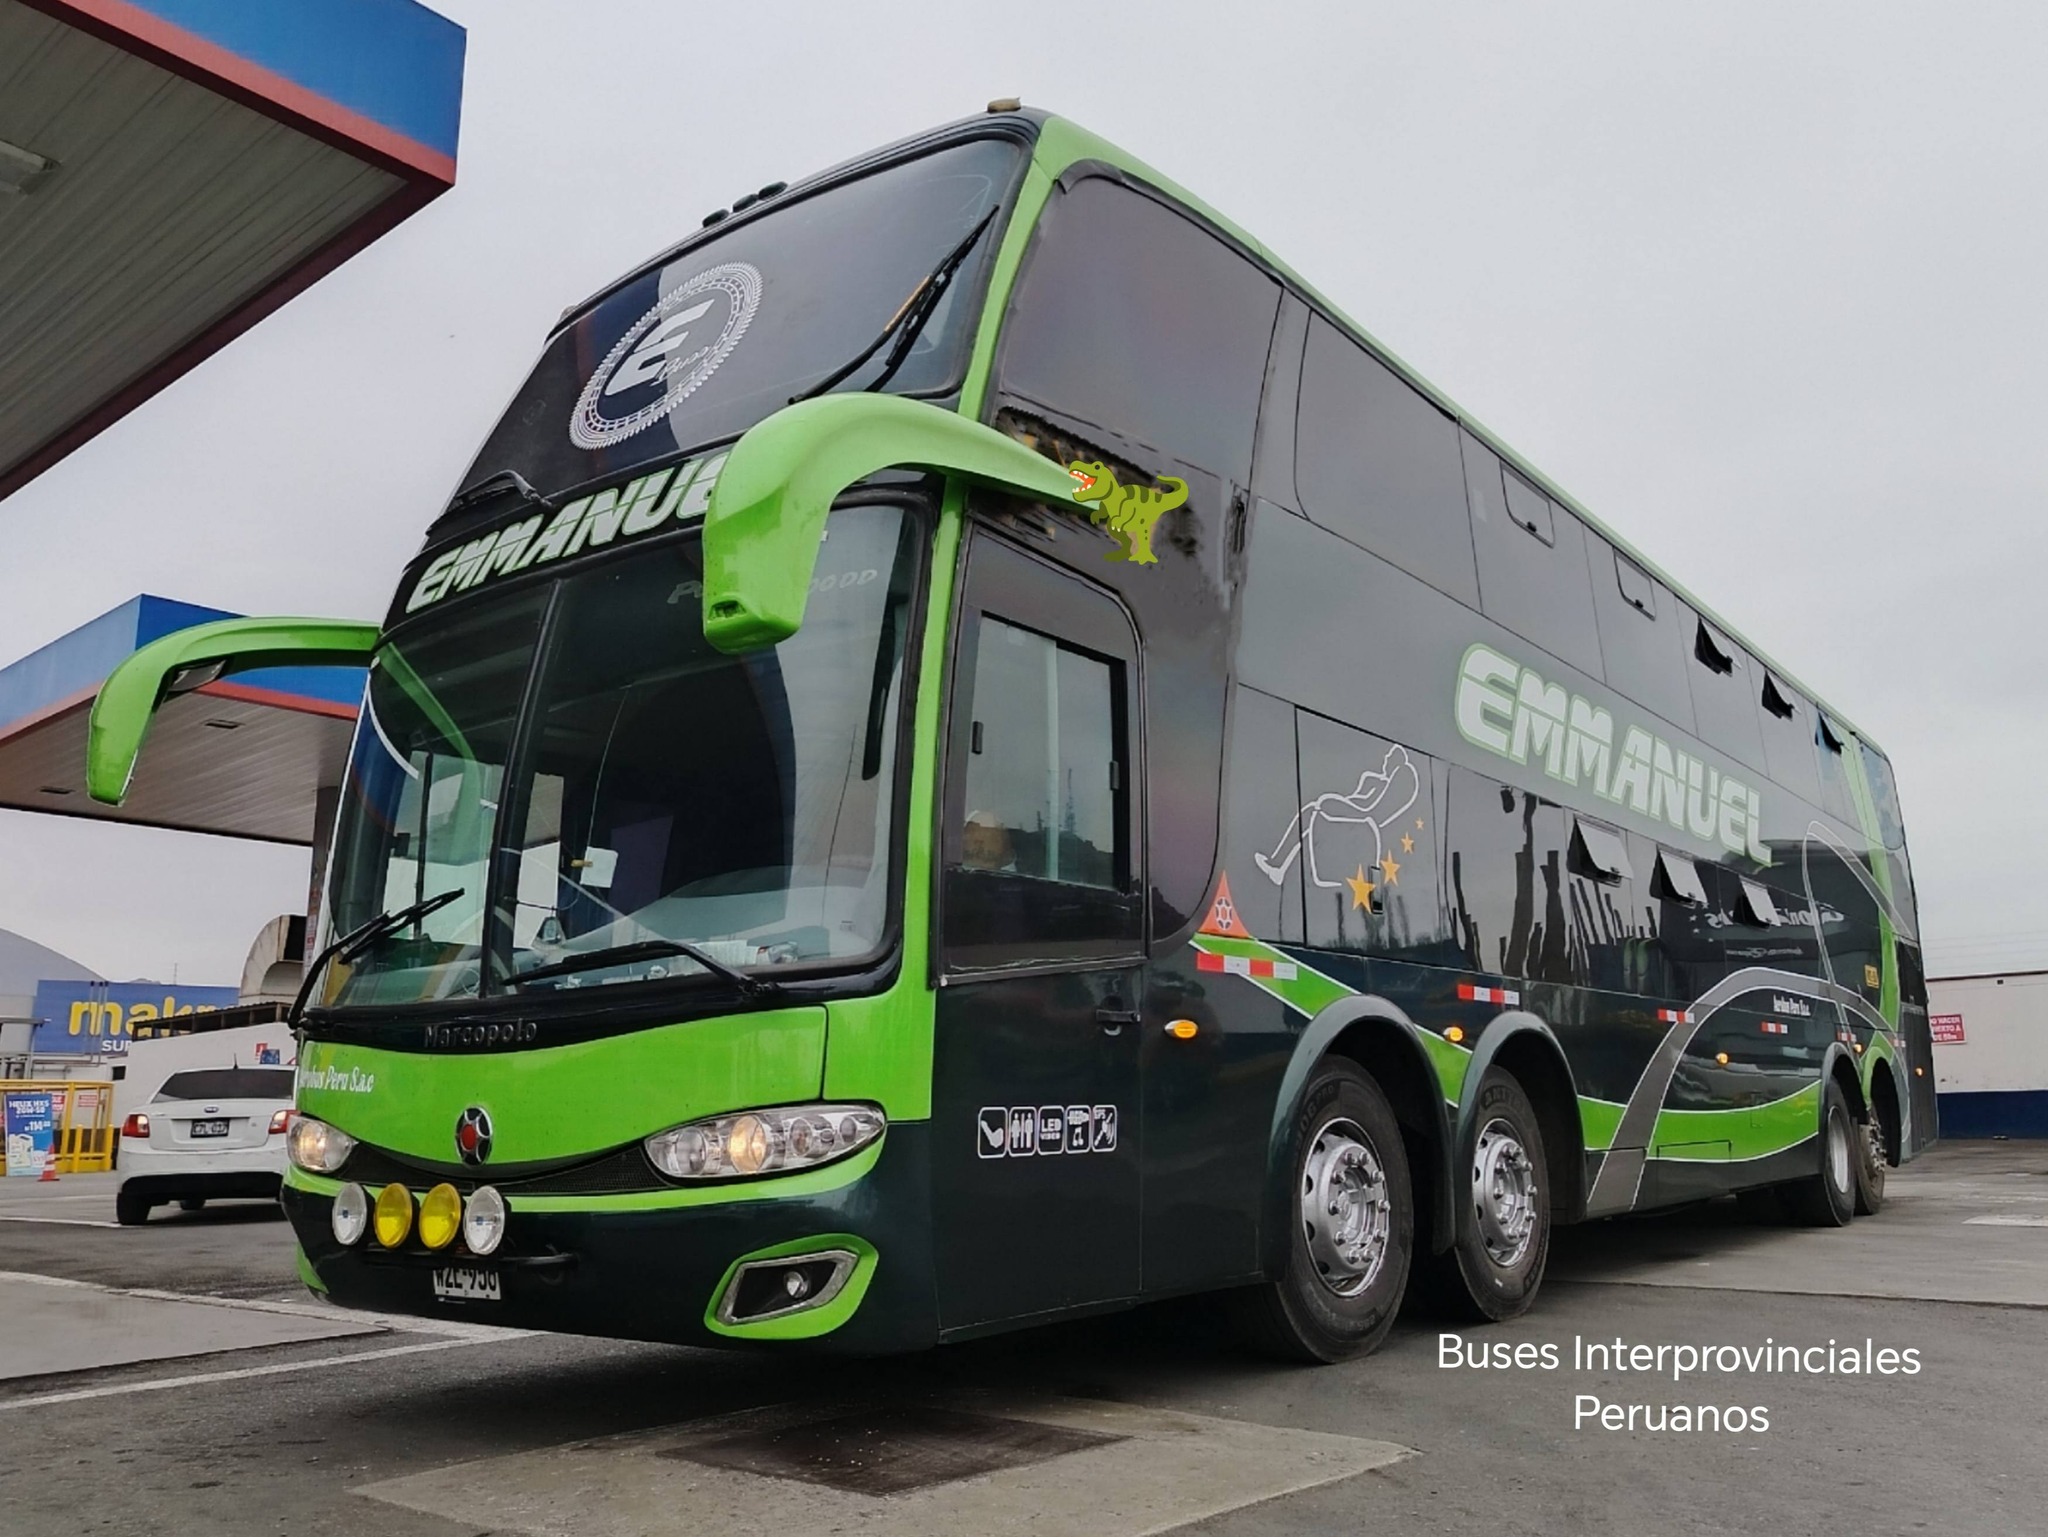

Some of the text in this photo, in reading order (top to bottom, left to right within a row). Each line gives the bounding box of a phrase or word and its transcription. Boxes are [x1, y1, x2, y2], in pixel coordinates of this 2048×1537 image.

[405, 452, 731, 614] EMMANUE
[1455, 643, 1773, 868] EMMANUEL
[68, 996, 240, 1037] mak
[424, 1018, 537, 1047] Marcopolo
[324, 1065, 349, 1091] Peru
[1041, 1118, 1062, 1133] LED
